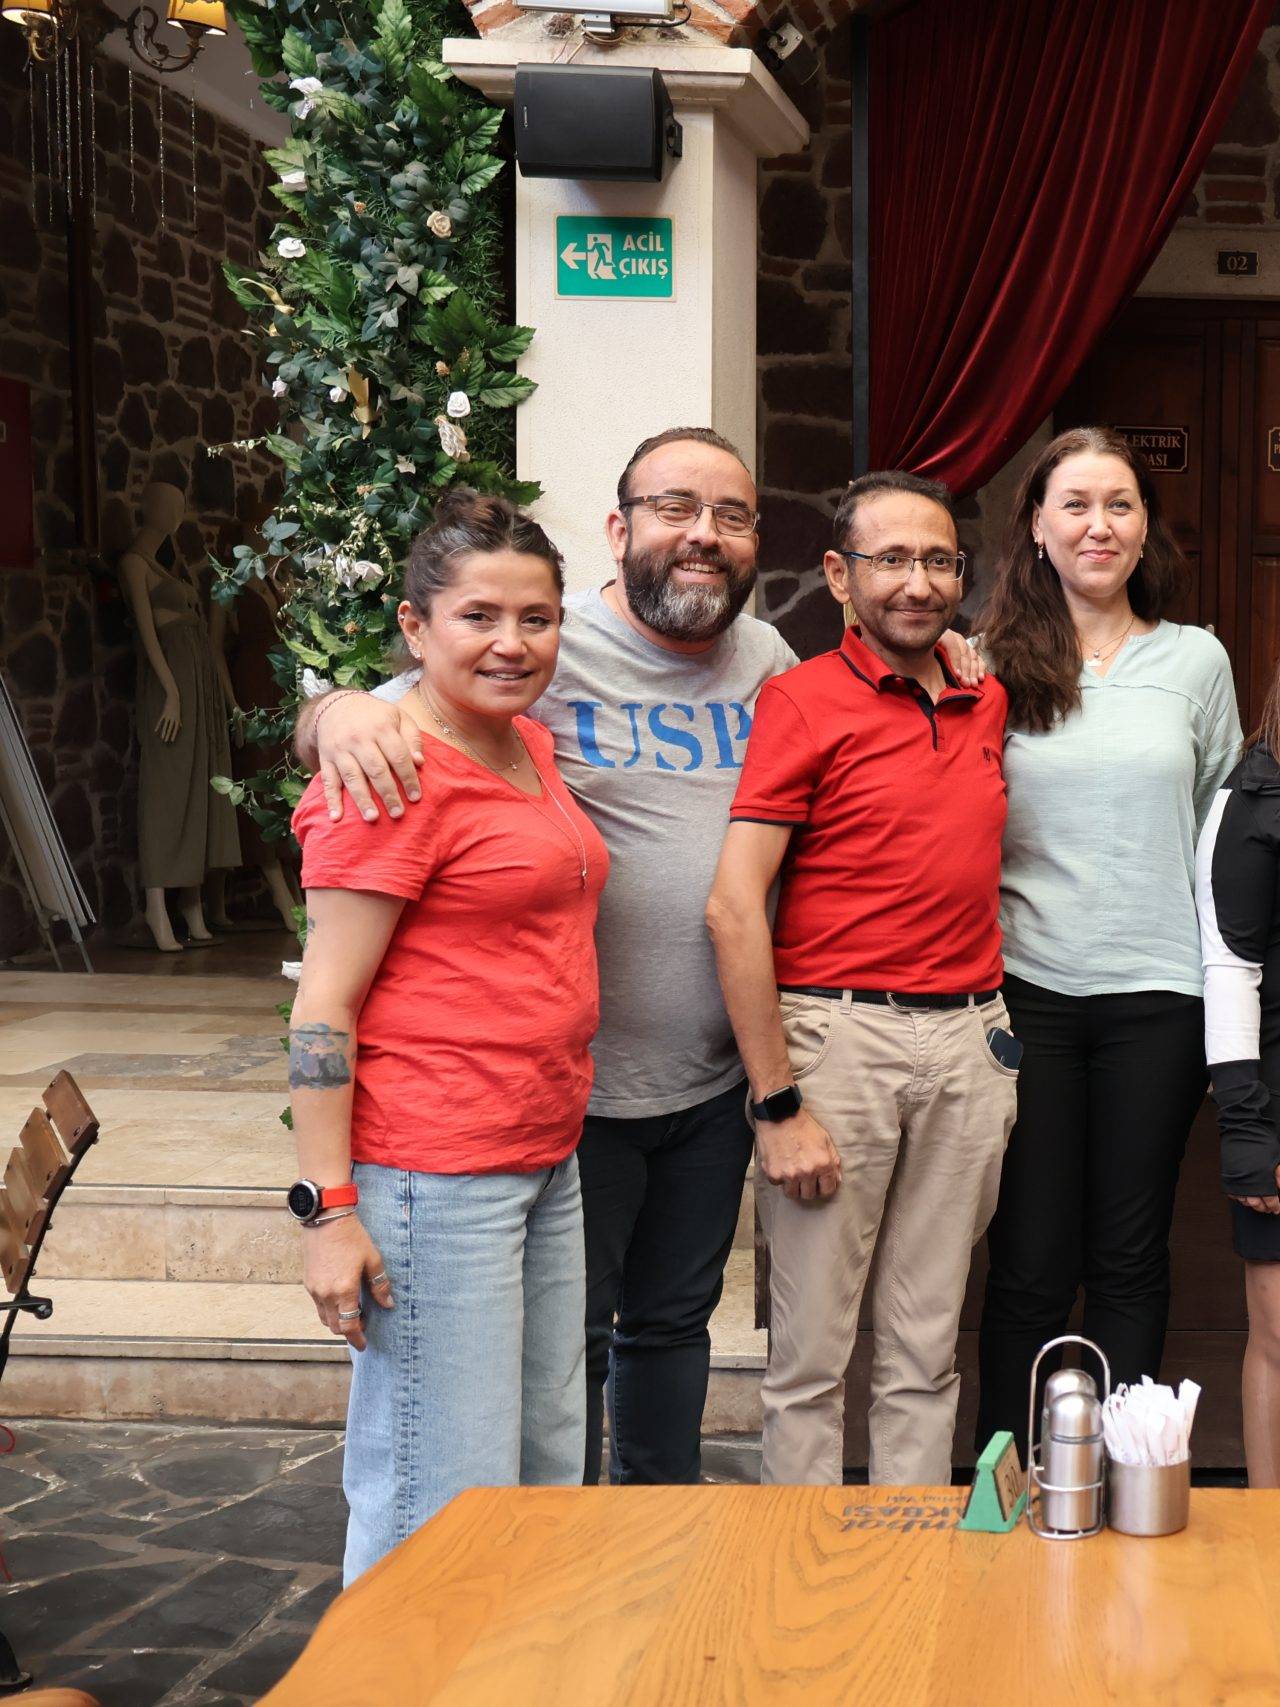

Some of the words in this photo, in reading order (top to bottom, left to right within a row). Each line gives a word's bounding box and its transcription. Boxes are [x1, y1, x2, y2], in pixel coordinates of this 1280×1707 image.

[622, 231, 665, 252] ACİL
[618, 257, 669, 280] ÇIKIŞ
[1226, 255, 1248, 271] 02
